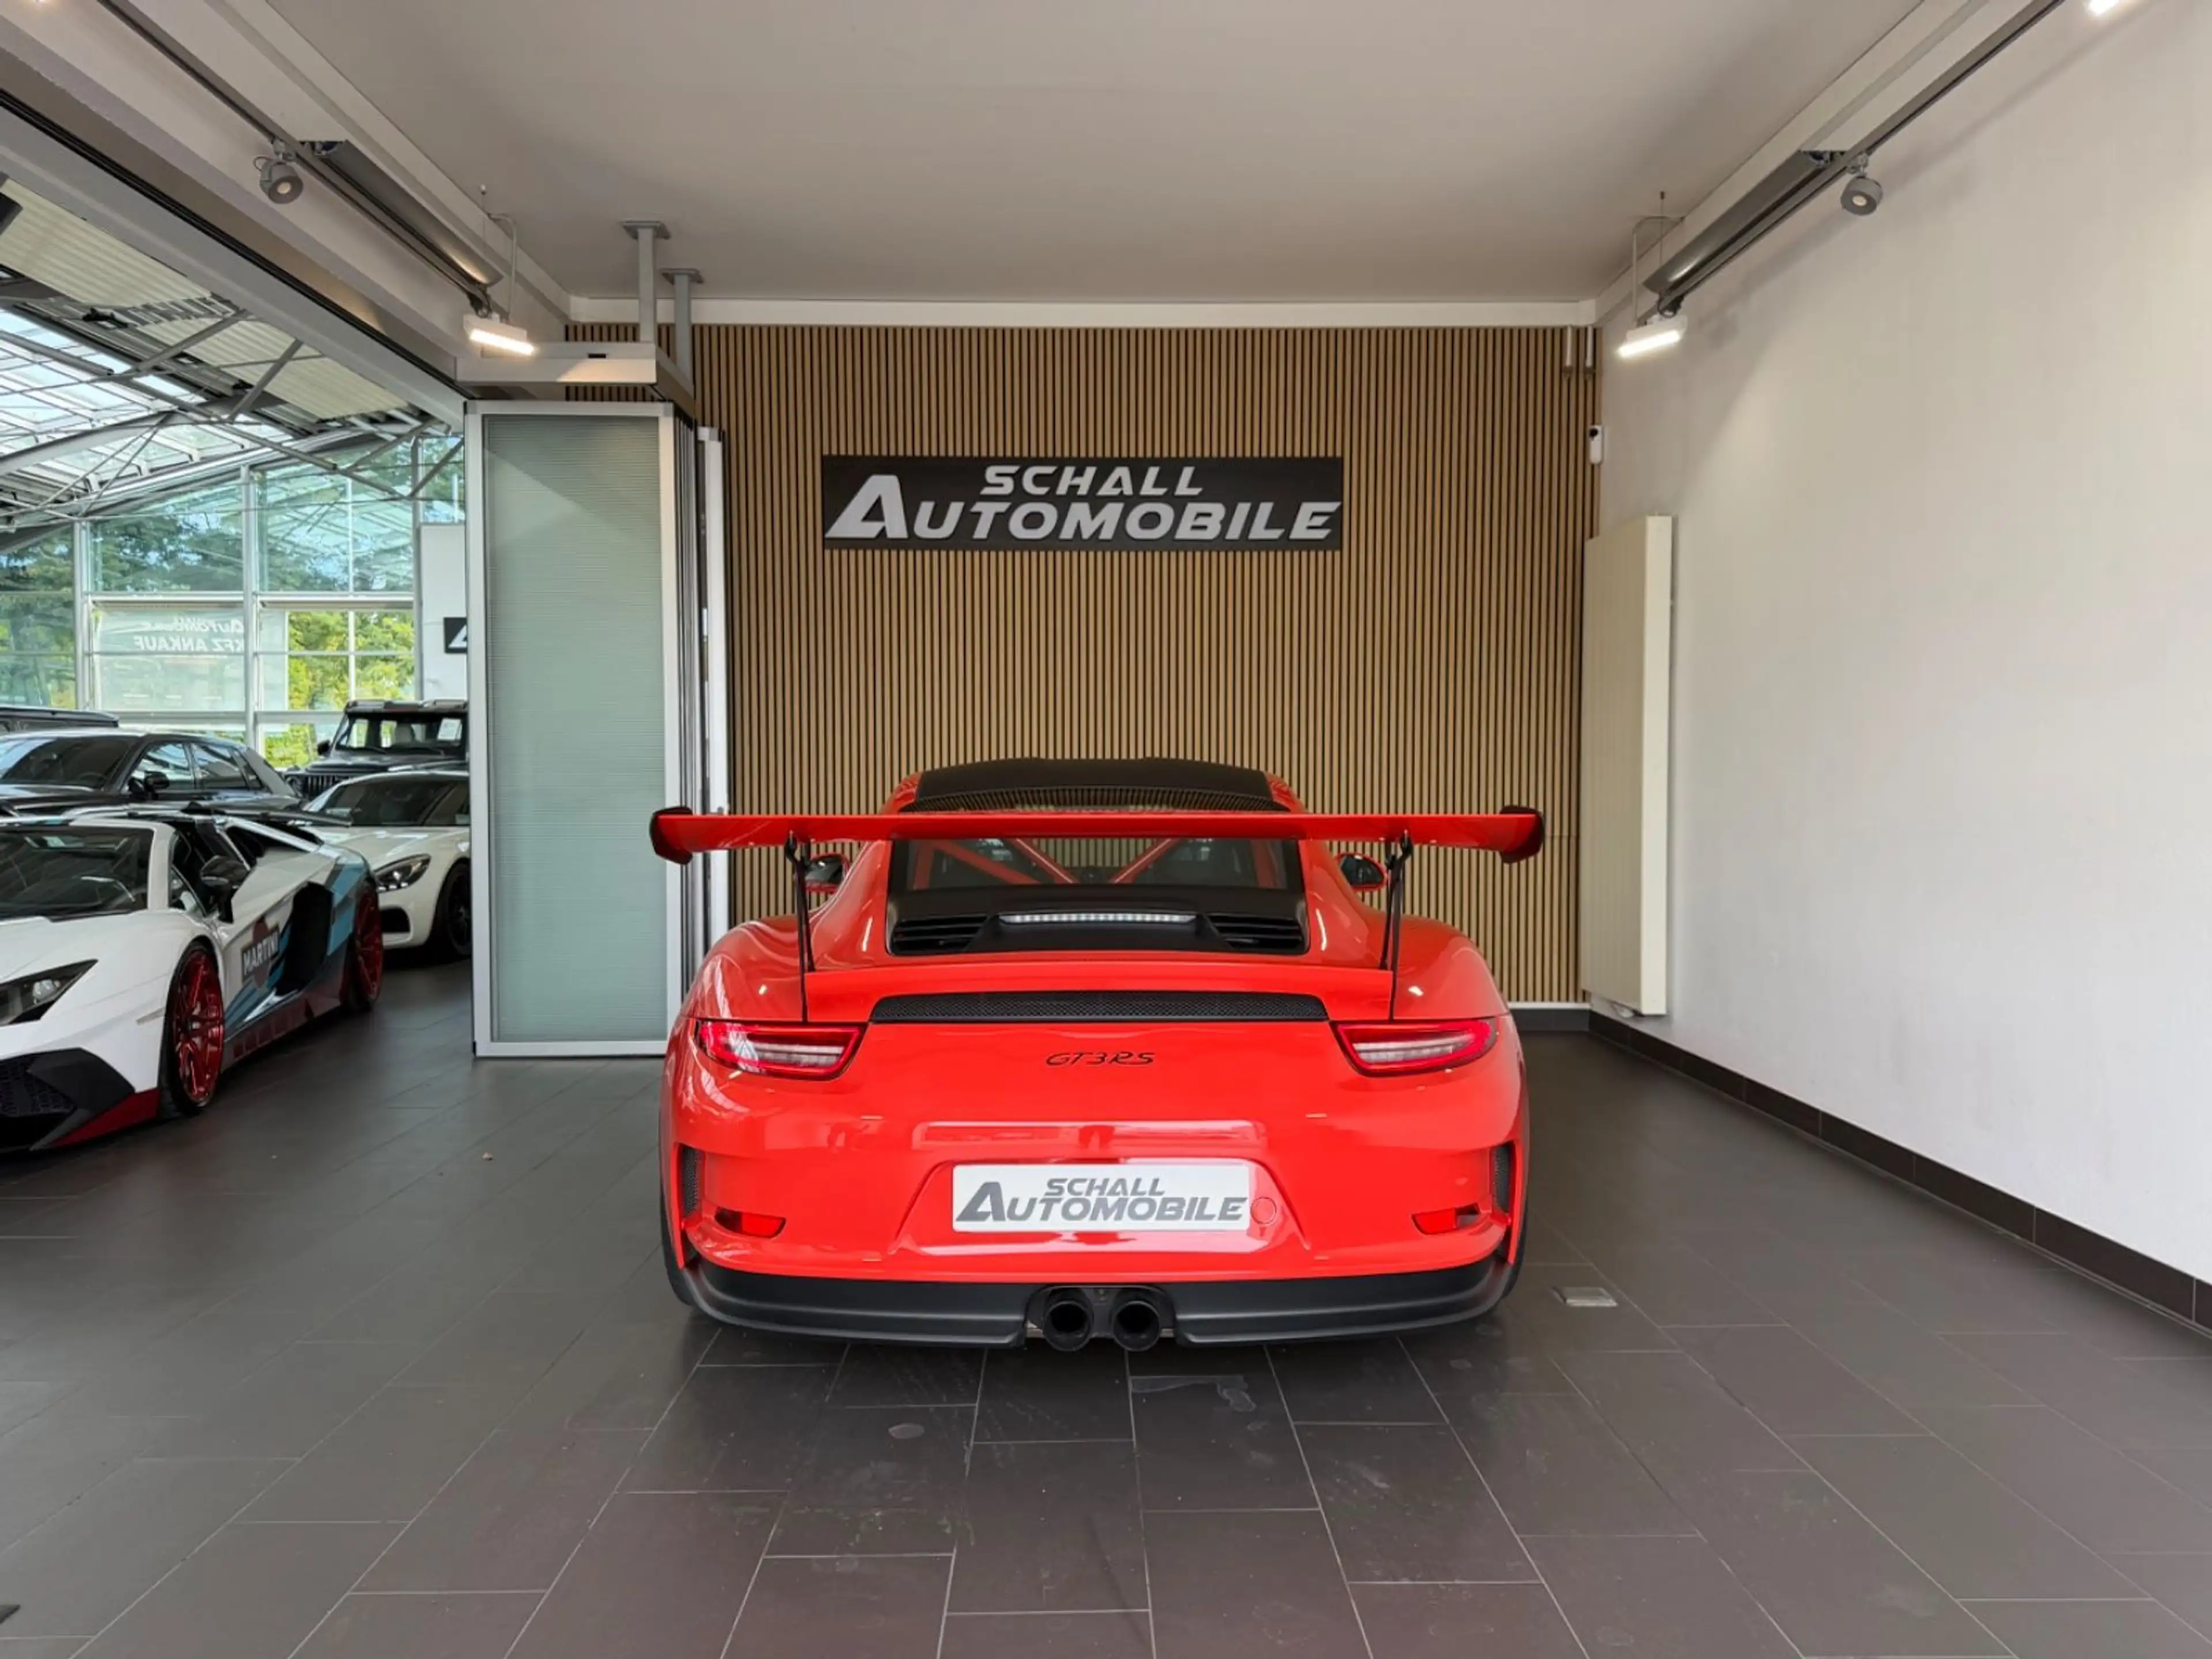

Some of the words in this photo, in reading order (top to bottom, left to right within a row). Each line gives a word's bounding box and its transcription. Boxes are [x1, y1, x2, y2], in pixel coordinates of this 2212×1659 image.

[980, 465, 1203, 496] SCHALL
[824, 474, 1341, 540] AUTOMOBILE
[955, 1181, 1249, 1222] AUTOMOBILE
[1044, 1177, 1165, 1196] SCHALL
